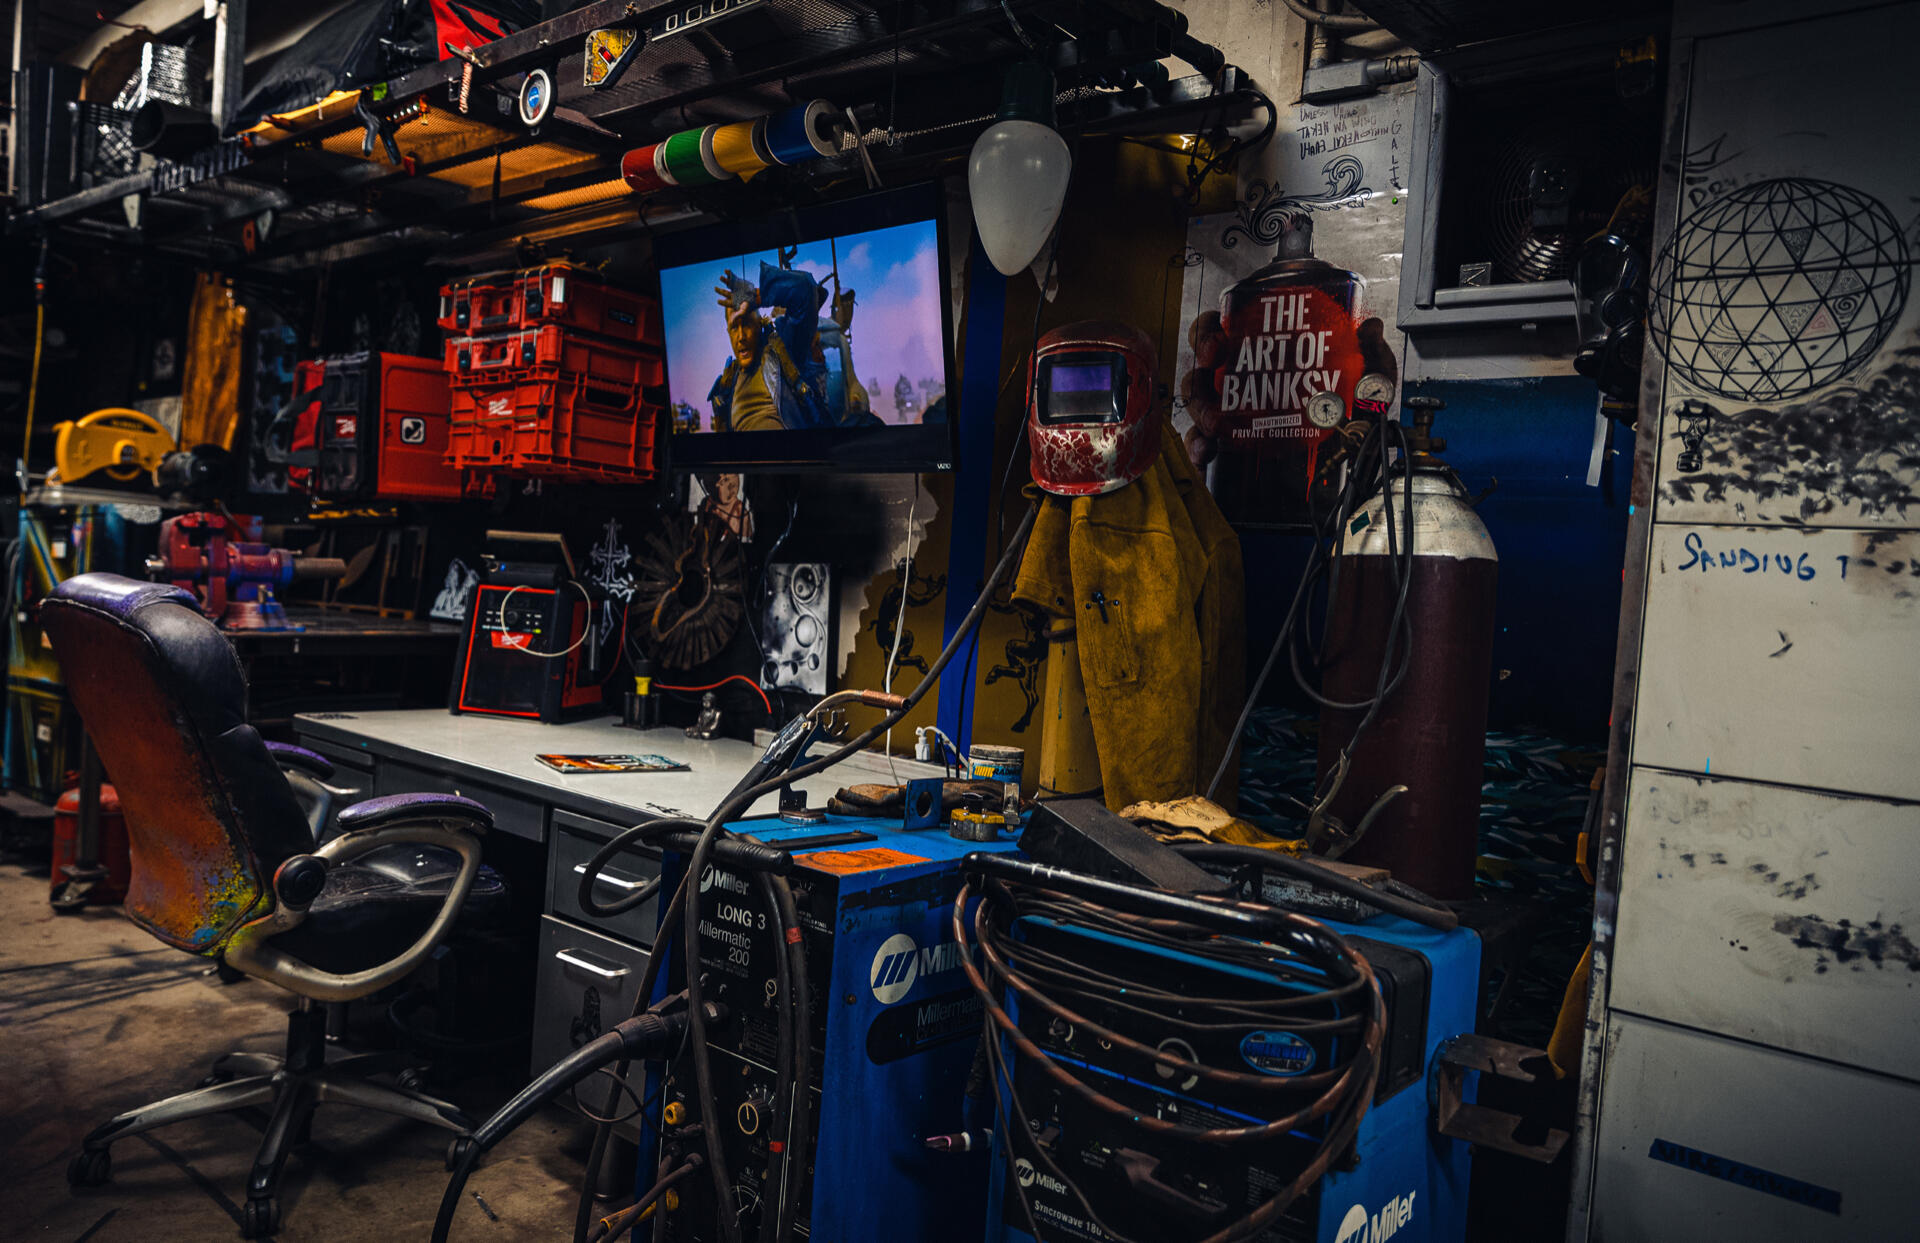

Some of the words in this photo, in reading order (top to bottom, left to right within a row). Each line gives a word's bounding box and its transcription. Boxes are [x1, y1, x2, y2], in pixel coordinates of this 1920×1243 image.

[1260, 292, 1313, 333] THE
[1234, 335, 1291, 373] ART
[1295, 331, 1332, 370] OF
[1221, 370, 1341, 412] BANKSY
[1232, 428, 1265, 439] PRIVATE
[1268, 427, 1320, 438] COLLECTION
[1254, 416, 1300, 429] UNAUTHORIZED
[714, 868, 750, 895] Miller
[717, 902, 752, 928] LONG
[757, 913, 766, 930] 3
[698, 919, 752, 950] Millermatic
[728, 946, 750, 966] 200
[1036, 1171, 1068, 1195] Miller
[1034, 1199, 1084, 1229] Syncrowave
[1370, 1189, 1416, 1243] Miller
